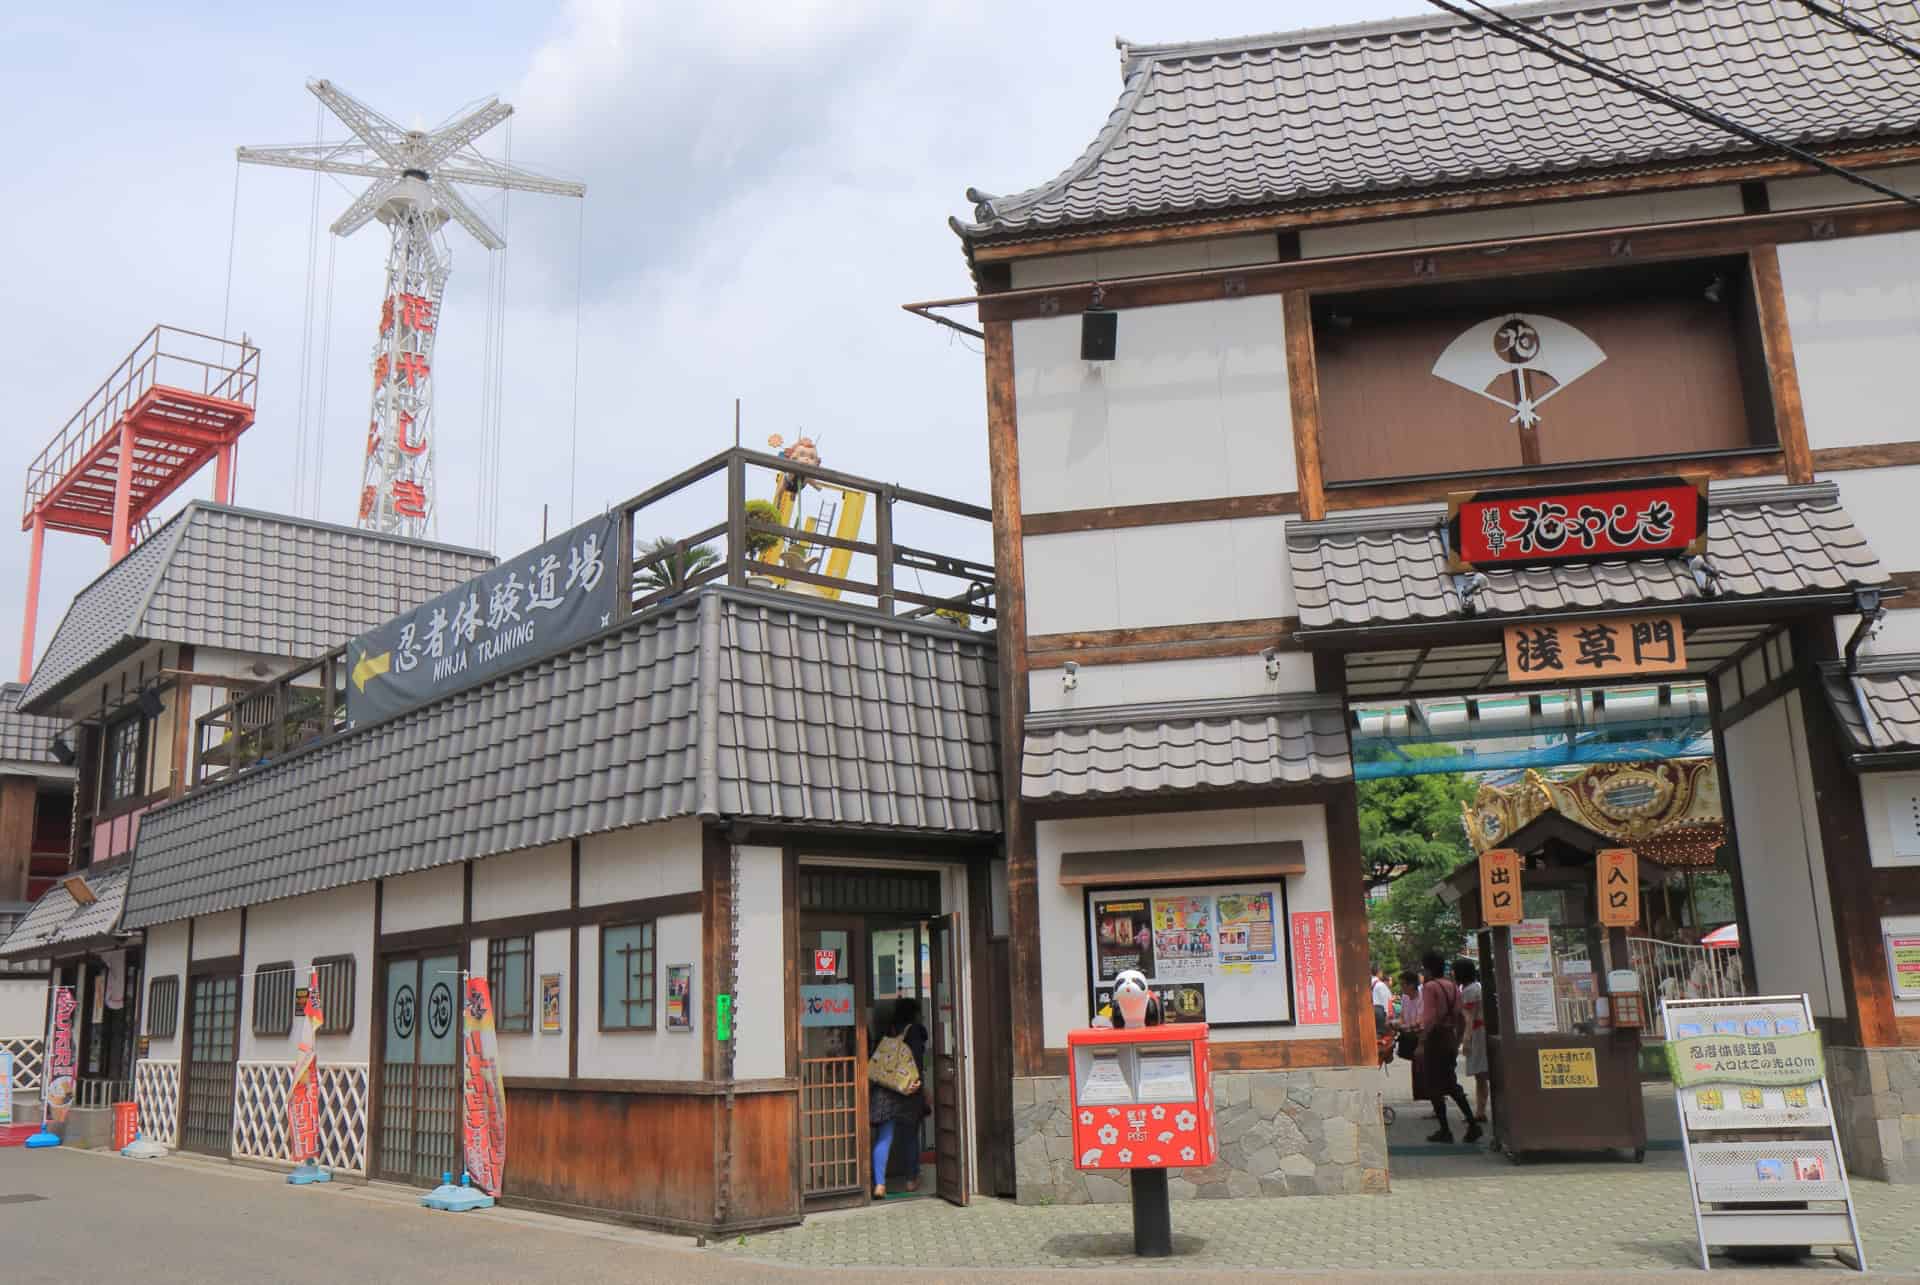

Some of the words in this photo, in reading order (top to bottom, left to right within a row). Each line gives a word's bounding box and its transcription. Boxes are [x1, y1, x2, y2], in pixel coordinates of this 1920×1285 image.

[1482, 507, 1505, 556] 浅草
[1505, 500, 1674, 553] 花やしき
[395, 533, 606, 673] 忍者体験道場
[433, 651, 468, 683] NINJA
[478, 620, 535, 665] TRAINING
[1516, 618, 1677, 673] 浅草門
[1490, 867, 1512, 908] 出口
[1607, 867, 1629, 908] 入口
[1715, 1056, 1816, 1072] 入口はこの先40m
[1127, 1131, 1148, 1142] POST
